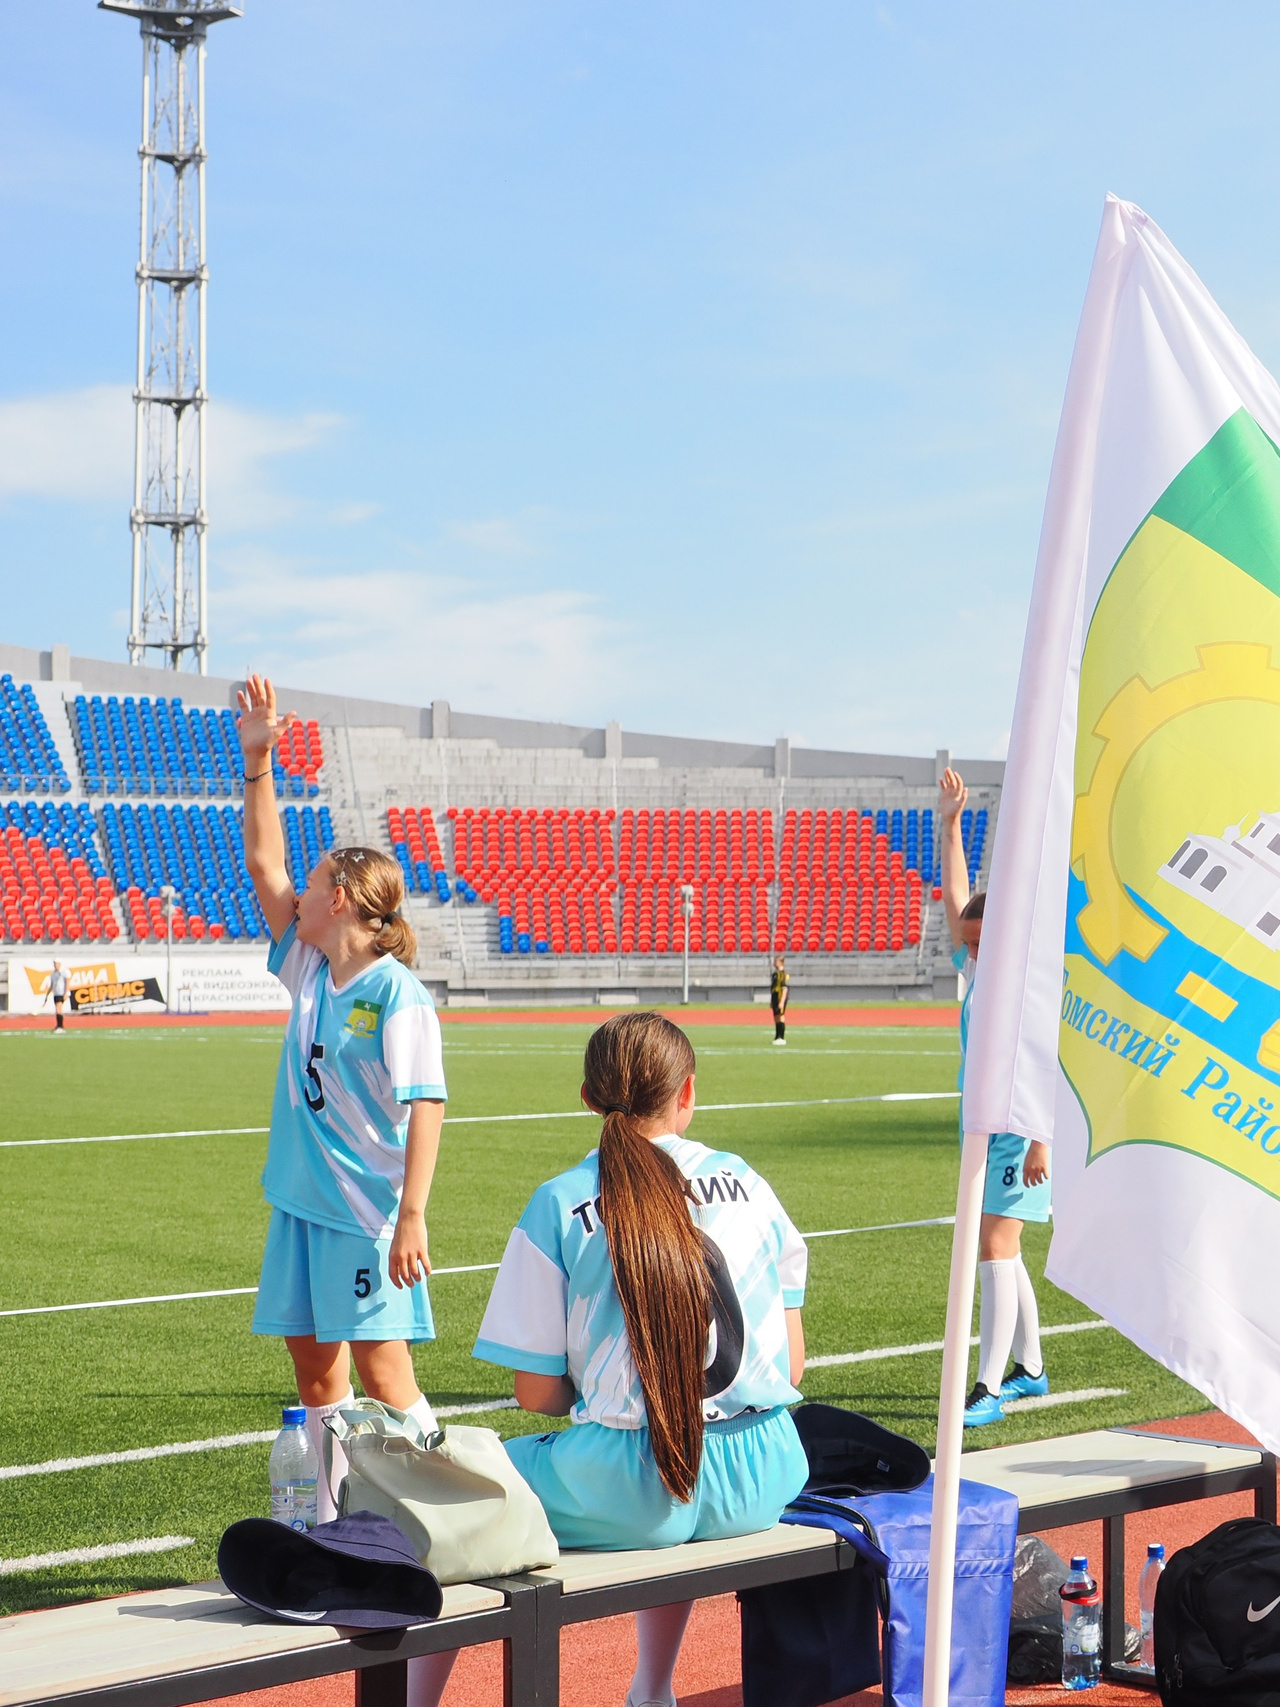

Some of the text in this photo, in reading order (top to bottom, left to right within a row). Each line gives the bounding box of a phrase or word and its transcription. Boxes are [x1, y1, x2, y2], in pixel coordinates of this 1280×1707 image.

[181, 968, 243, 977] РЕКЛАМА
[74, 980, 146, 1004] СЕРВИС
[203, 980, 282, 990] ВИДЕОЭКРА
[193, 992, 282, 1002] КРАСНОЯРСКЕ
[1061, 967, 1181, 1079] омский
[304, 1041, 325, 1113] 5
[1002, 1165, 1015, 1187] 8
[353, 1268, 371, 1299] 5
